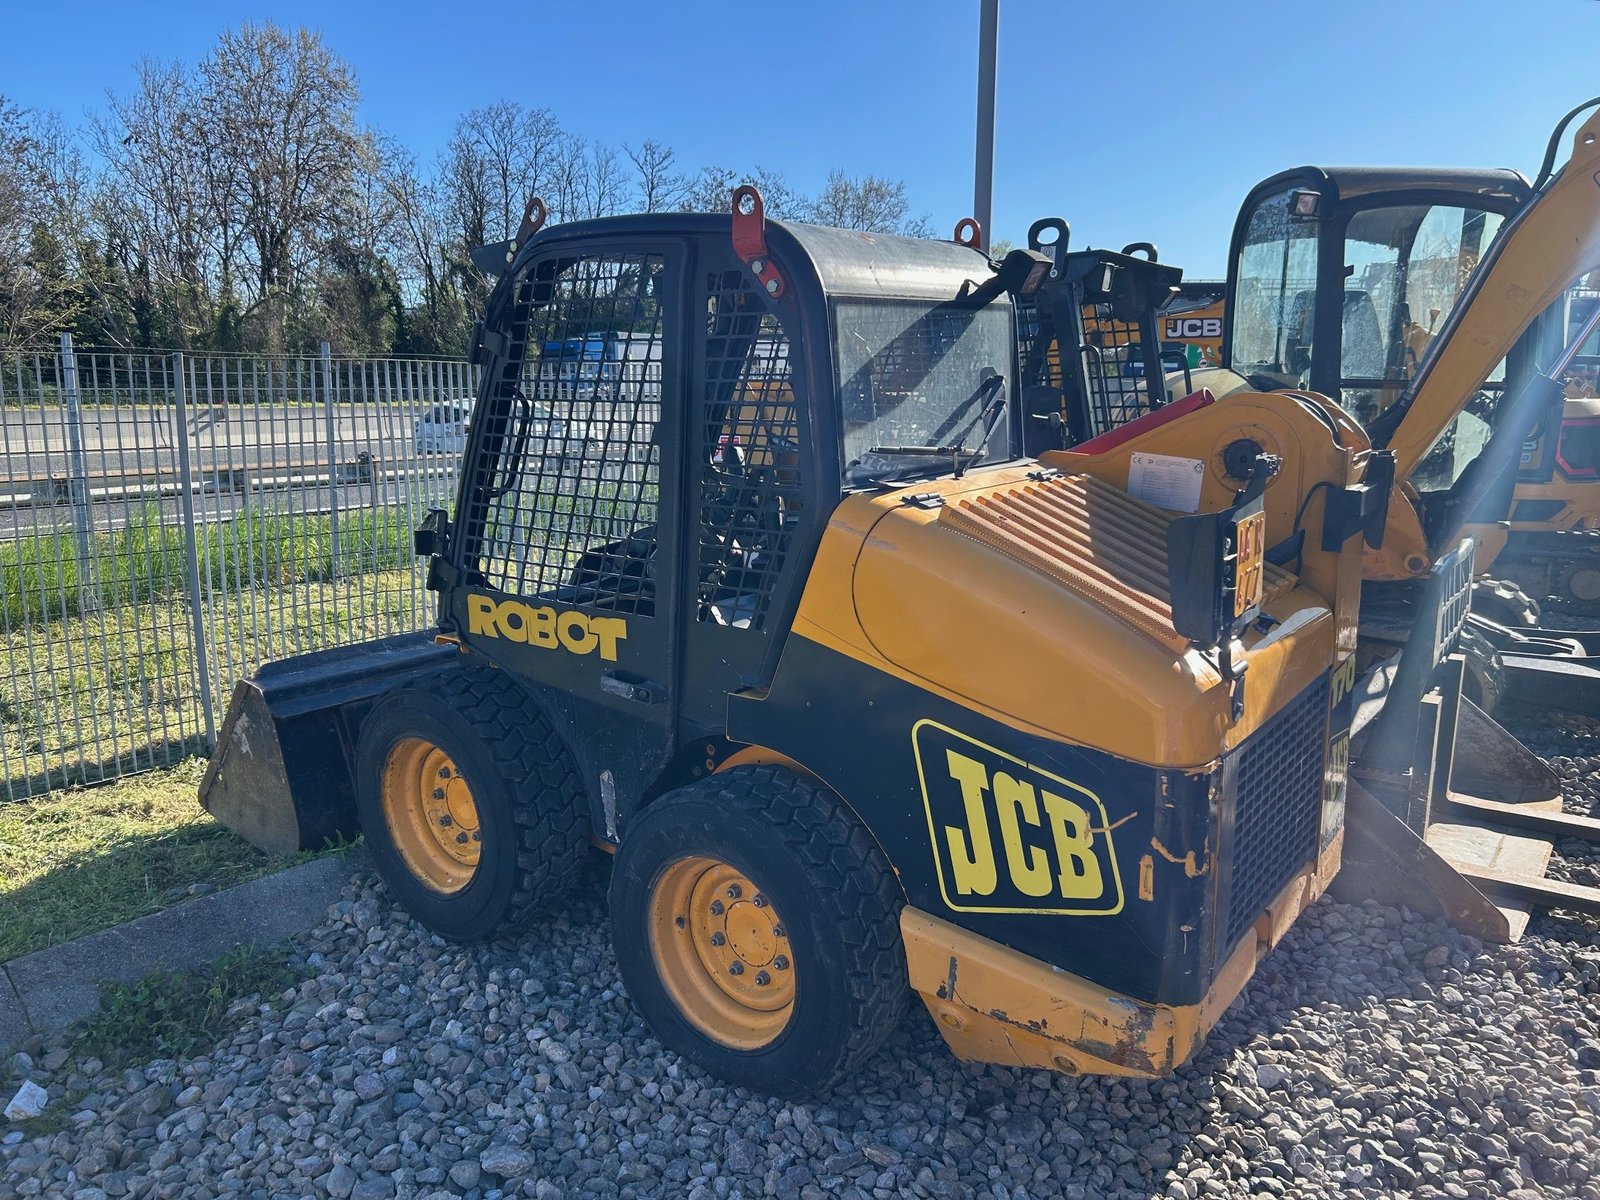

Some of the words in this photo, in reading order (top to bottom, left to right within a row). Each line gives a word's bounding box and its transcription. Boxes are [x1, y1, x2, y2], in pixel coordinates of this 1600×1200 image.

[1167, 319, 1221, 337] JCB
[467, 593, 627, 662] ROBOT
[1331, 652, 1356, 710] 170
[945, 748, 1104, 899] JCB
